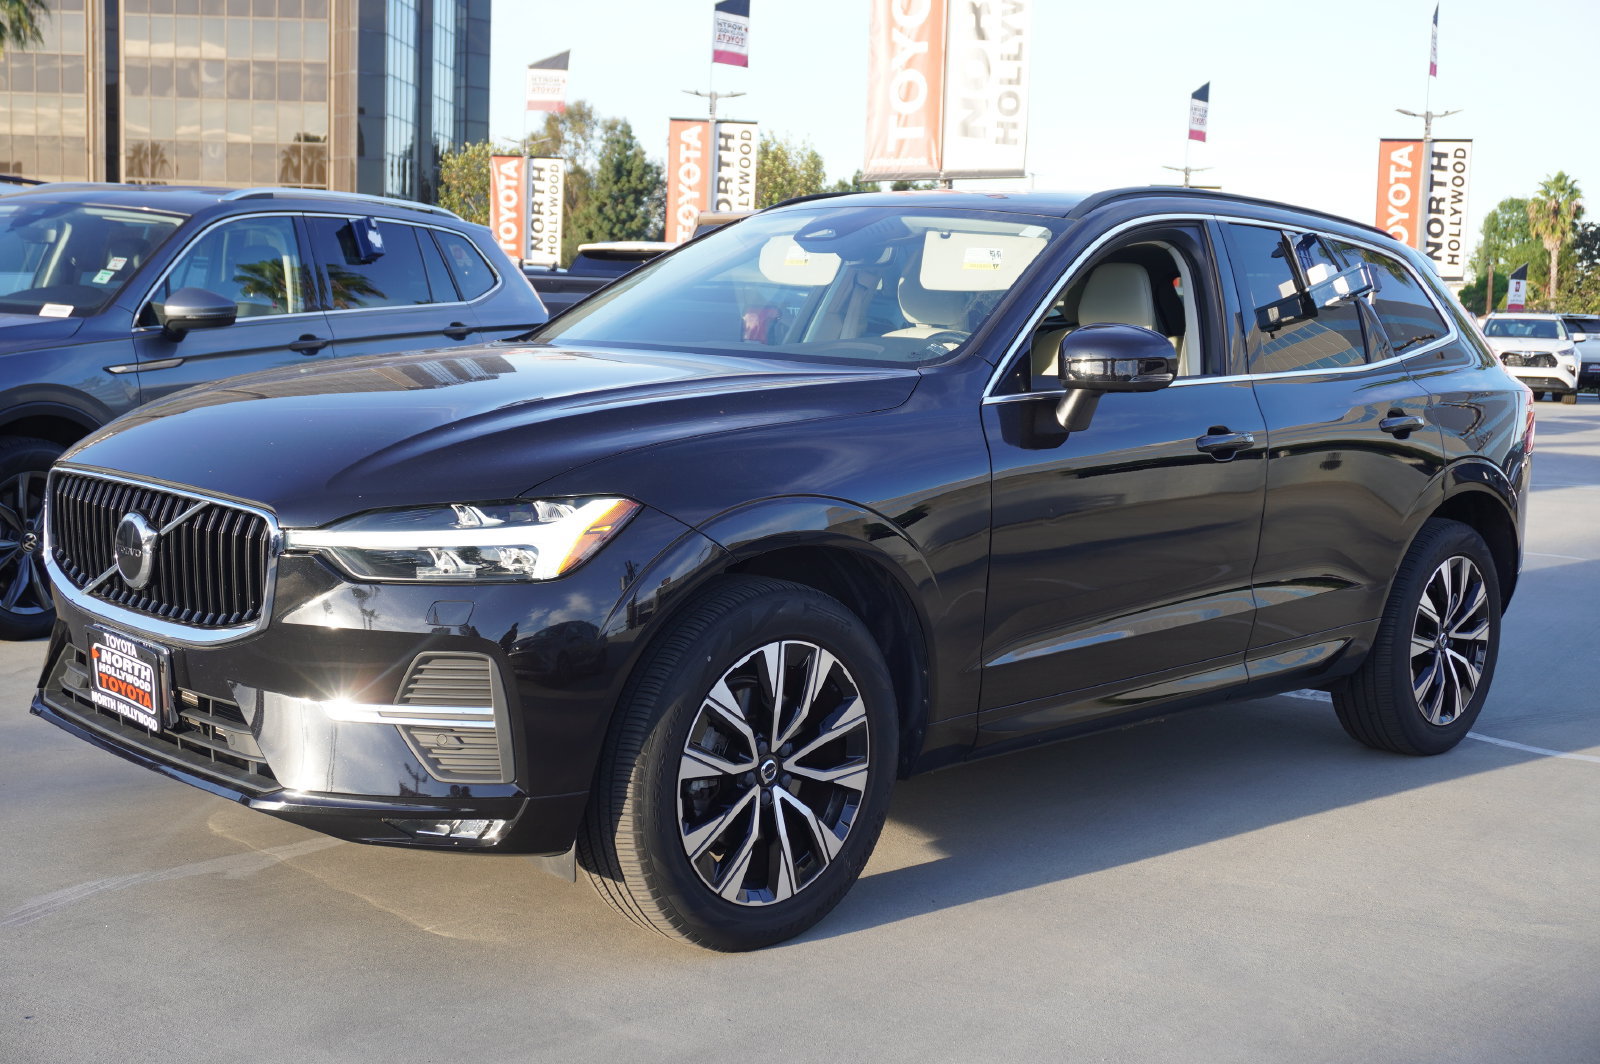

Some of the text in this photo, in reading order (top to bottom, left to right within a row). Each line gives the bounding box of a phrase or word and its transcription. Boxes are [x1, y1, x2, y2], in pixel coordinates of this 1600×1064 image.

[886, 0, 932, 153] TOYO
[498, 159, 519, 253] TOYOTA
[531, 166, 545, 252] NORTH
[716, 132, 735, 211] ORTH
[738, 130, 752, 207] LYWOOD
[1386, 145, 1414, 245] OYOTA
[1425, 151, 1449, 261] NORTH
[1447, 148, 1467, 266] HOLLYWOOD
[547, 164, 559, 256] HOLLYWOOD
[98, 661, 151, 692] HOLLYWOOD
[101, 649, 151, 682] NORTH
[103, 633, 137, 658] TOYOTA
[91, 690, 158, 731] NORTH HOLLYWOOD
[98, 672, 153, 709] TOYOTA
